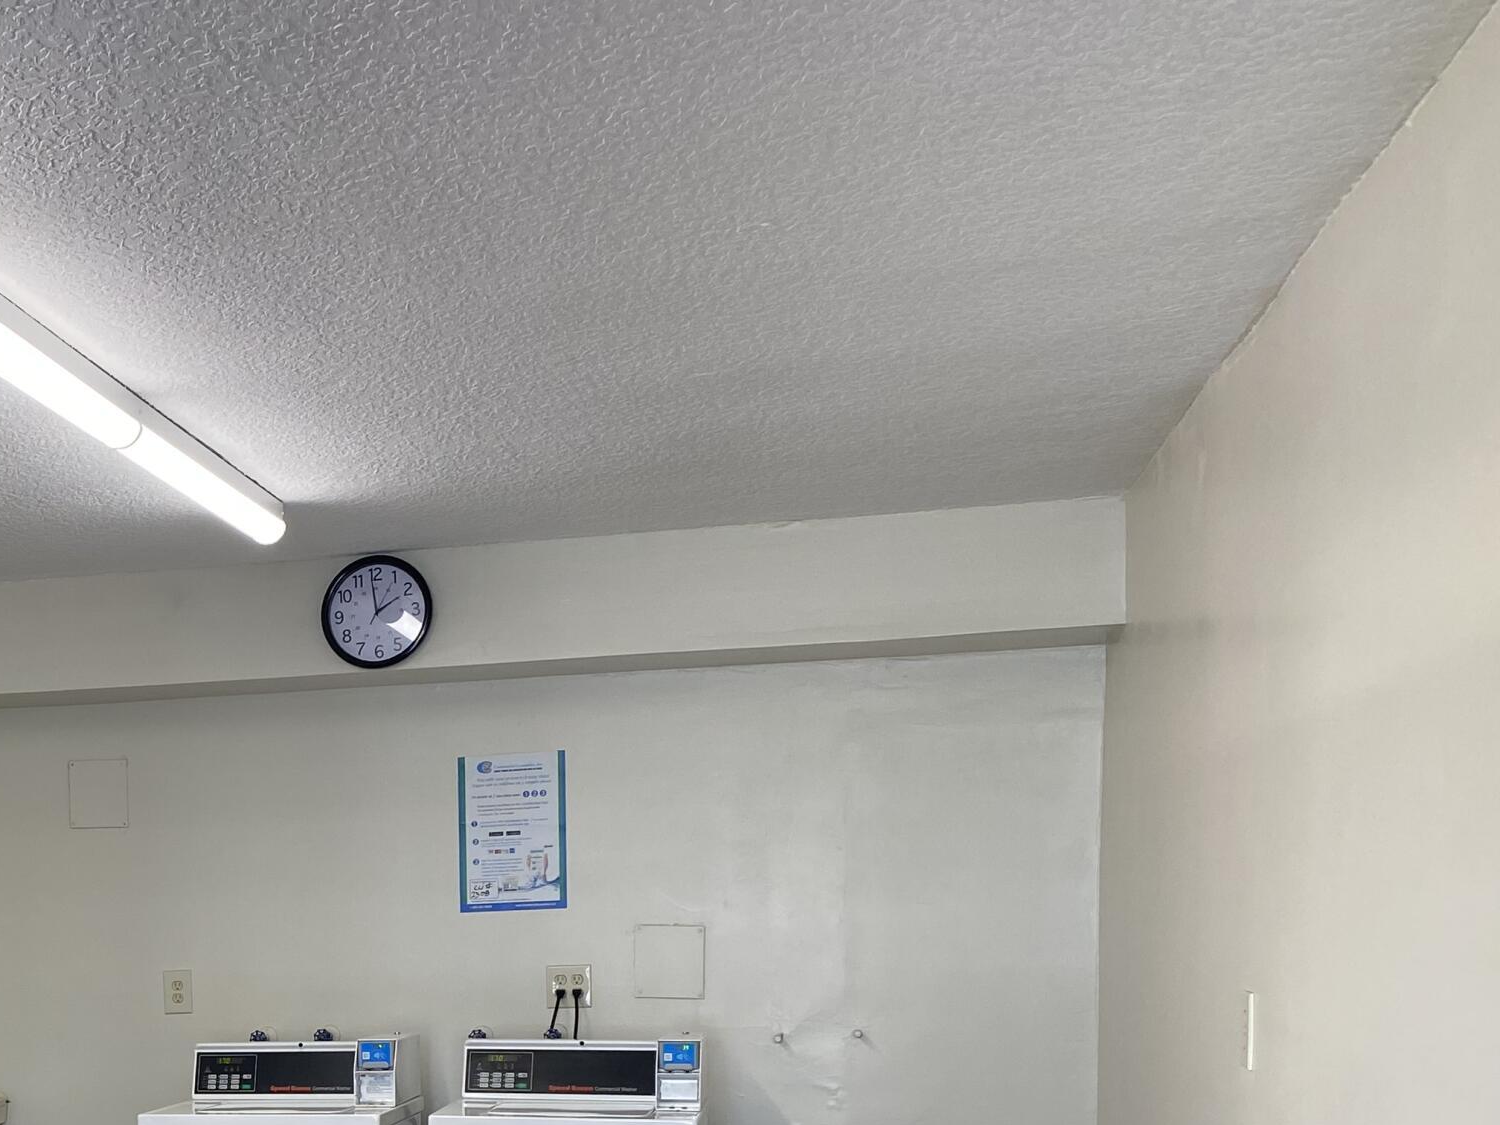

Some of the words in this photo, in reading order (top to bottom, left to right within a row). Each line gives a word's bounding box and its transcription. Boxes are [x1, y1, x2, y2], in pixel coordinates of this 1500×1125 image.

[368, 567, 382, 581] 12
[392, 570, 397, 584] 1
[352, 575, 363, 588] 11
[403, 582, 413, 596] 2
[337, 589, 352, 604] 10
[411, 602, 421, 616] 3
[334, 610, 344, 624] 9
[342, 629, 352, 643] 8
[356, 642, 366, 655] 7
[393, 637, 403, 651] 5
[374, 645, 384, 659] 6
